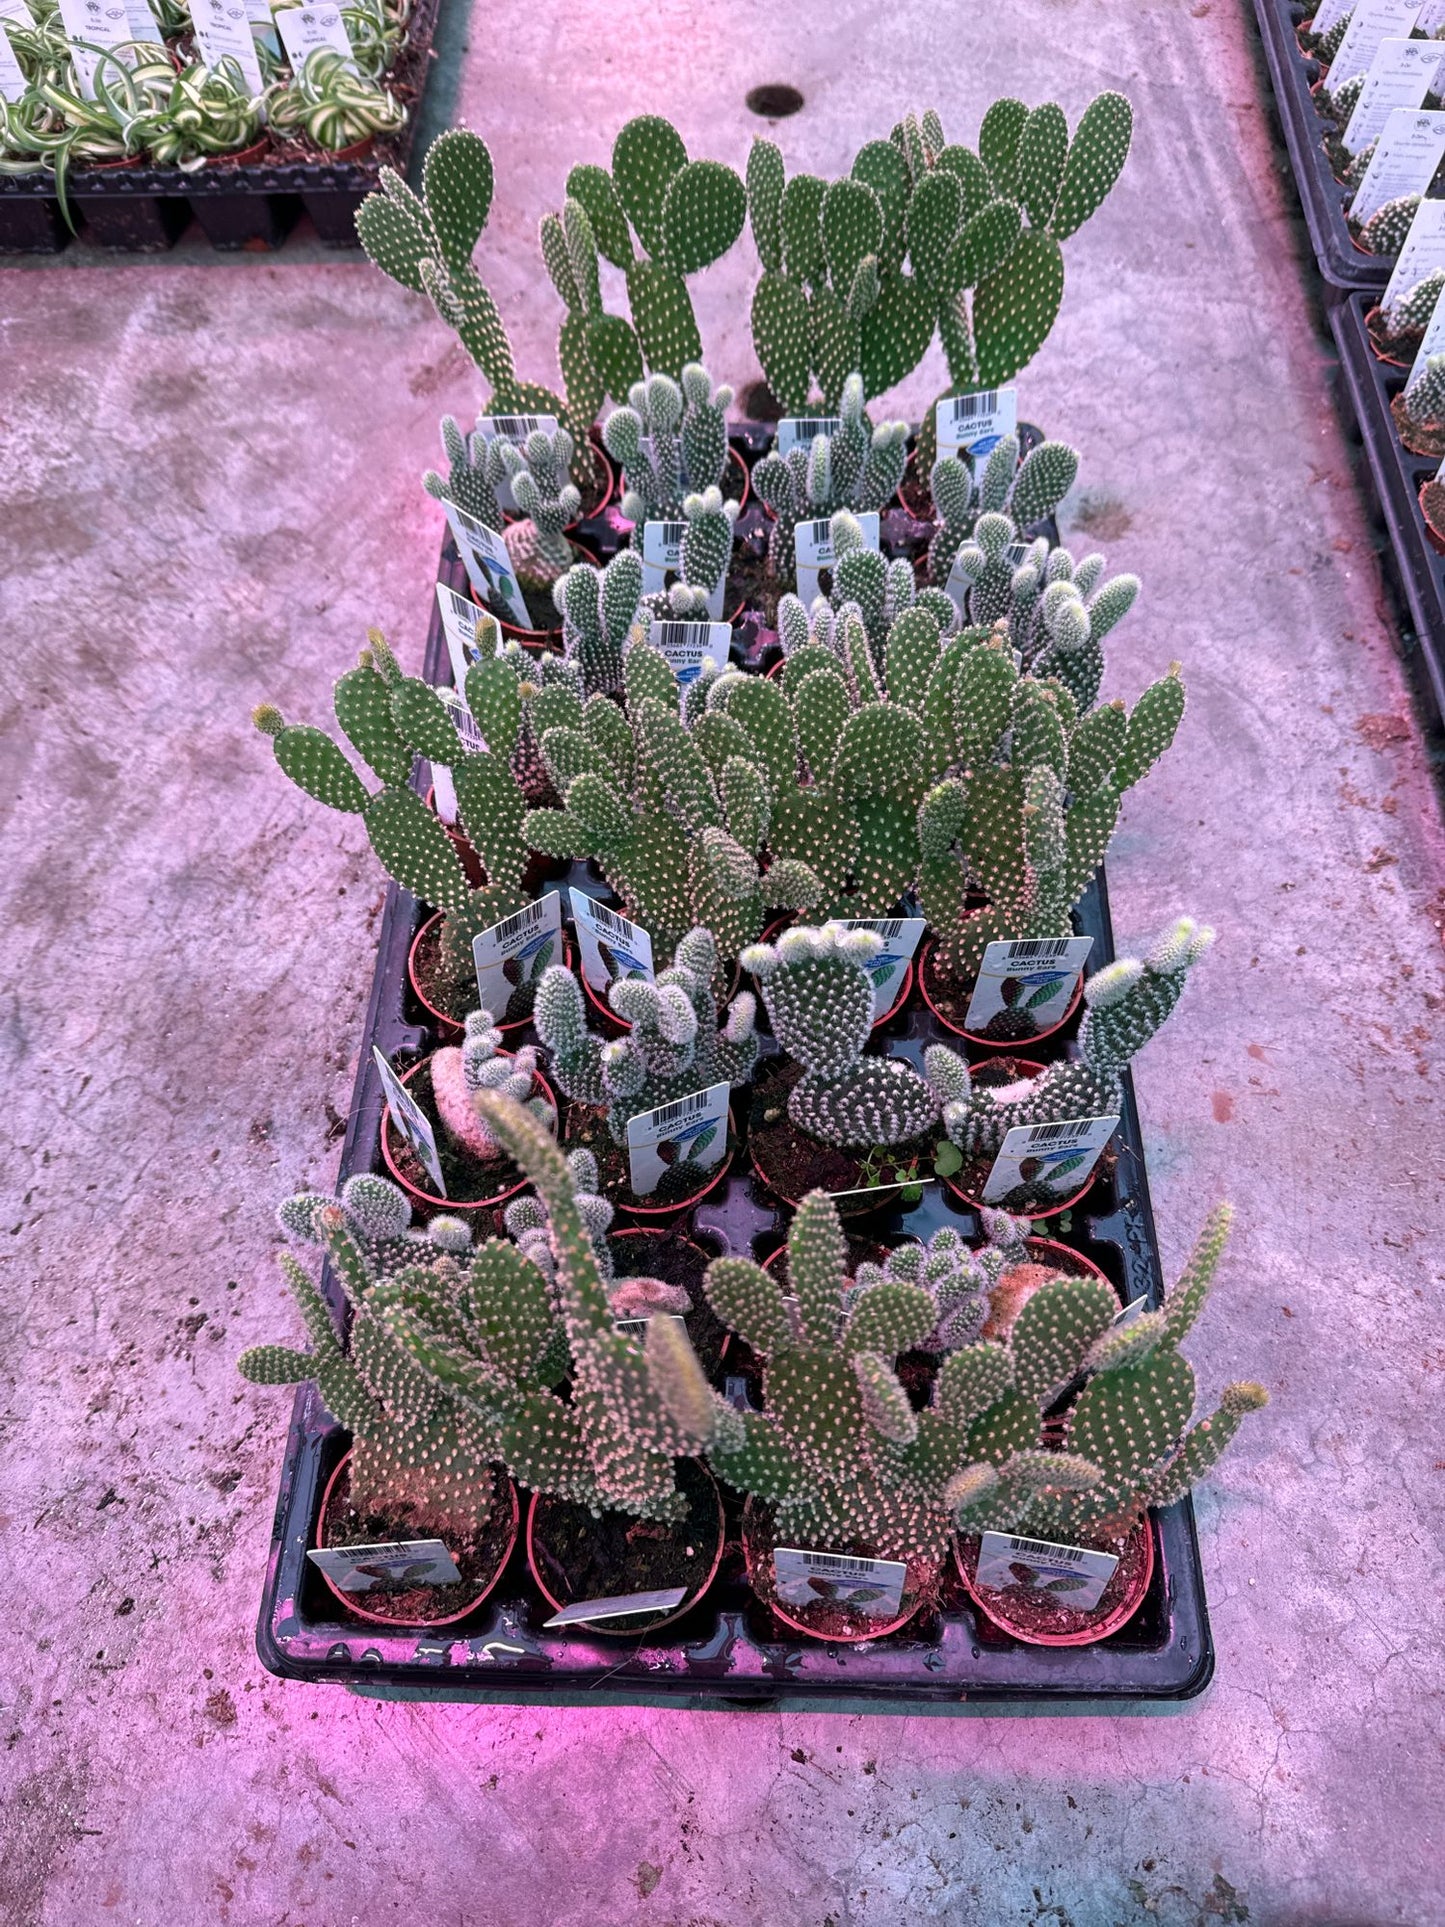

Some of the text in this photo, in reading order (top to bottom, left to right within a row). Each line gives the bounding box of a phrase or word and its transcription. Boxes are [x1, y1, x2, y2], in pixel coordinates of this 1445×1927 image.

[958, 420, 992, 432] CACTUS
[502, 925, 540, 949] CACTUS
[595, 923, 630, 948] CACTUS
[501, 940, 524, 956] Bunny
[1011, 959, 1056, 967] CACTUS
[656, 1117, 704, 1138] Bunny Ears
[658, 1112, 702, 1132] CACTUS
[1031, 1139, 1078, 1148] CACTUS
